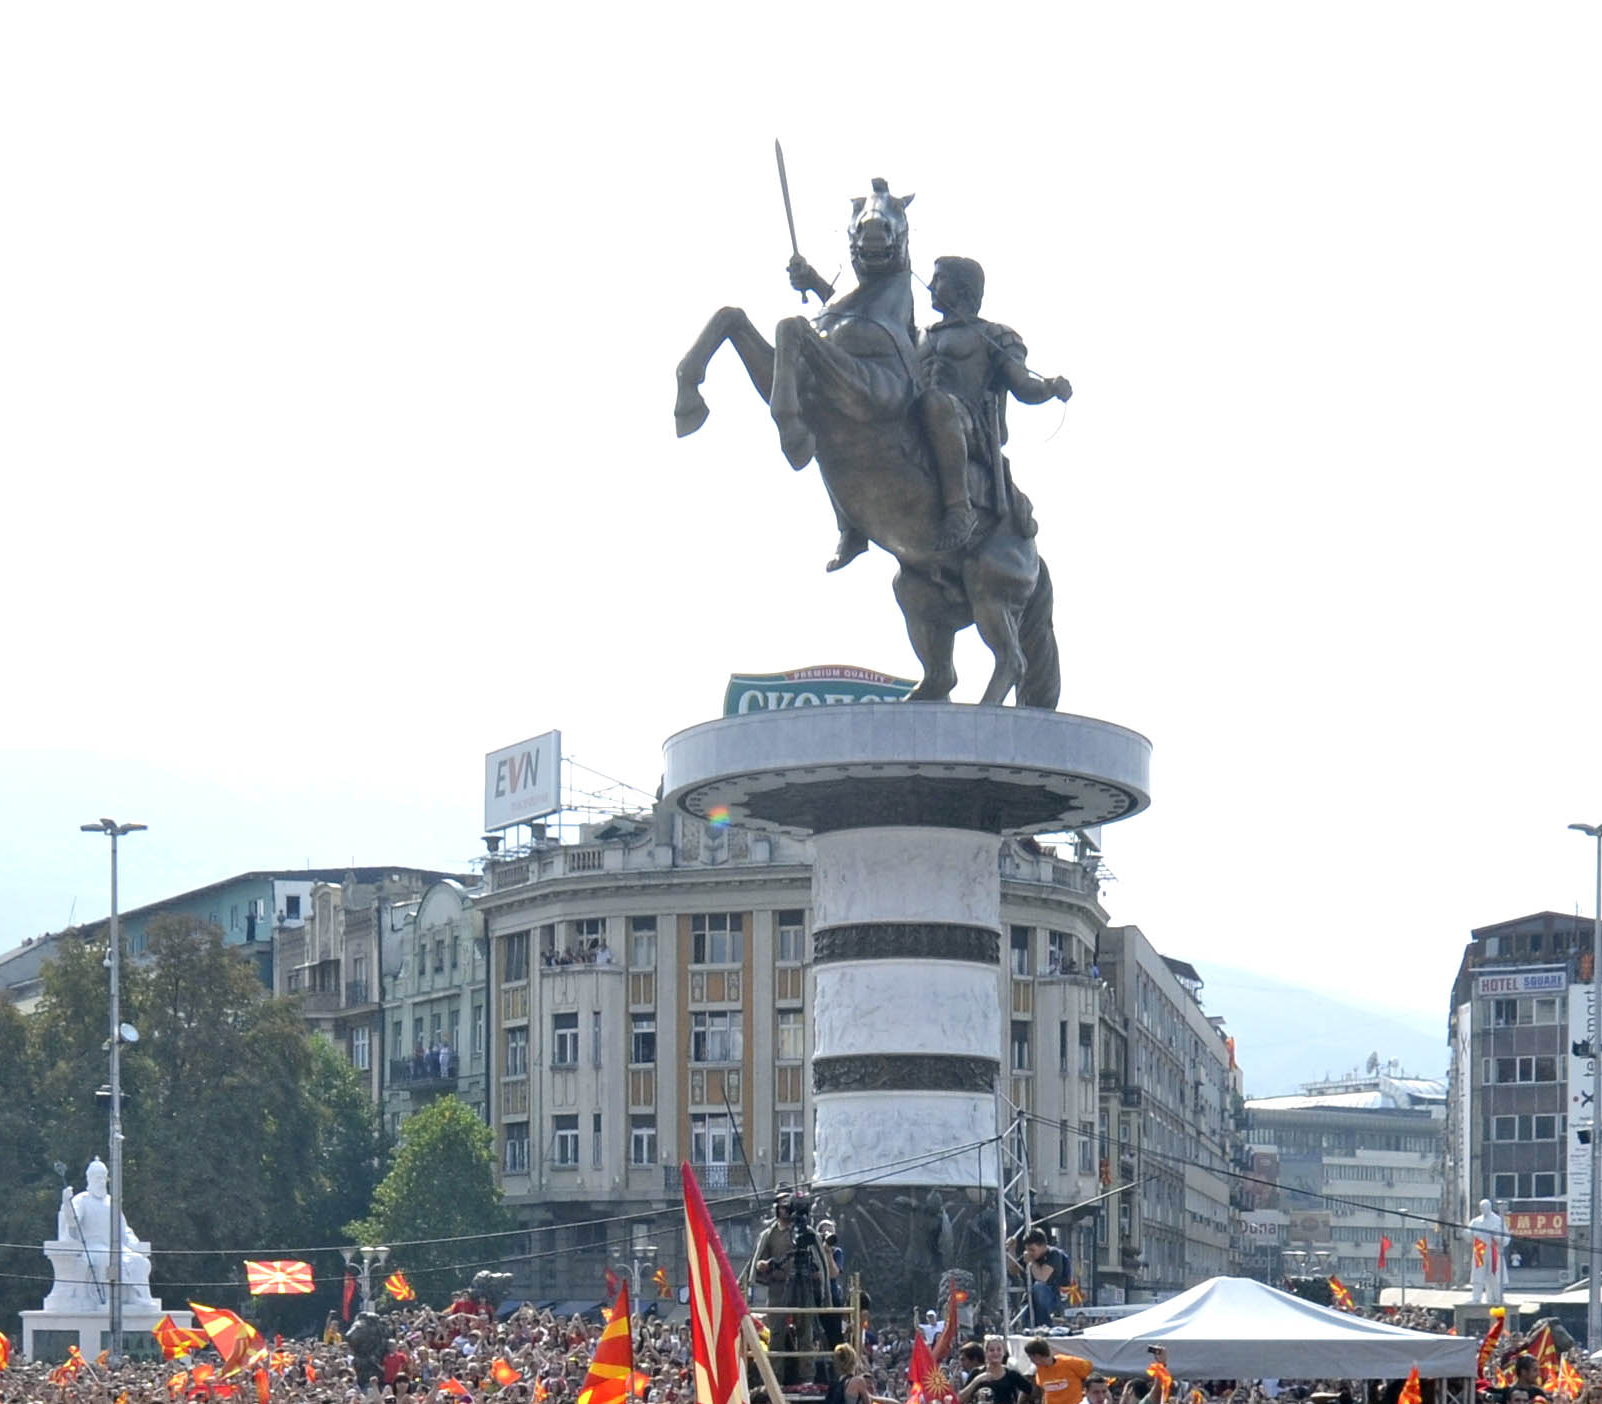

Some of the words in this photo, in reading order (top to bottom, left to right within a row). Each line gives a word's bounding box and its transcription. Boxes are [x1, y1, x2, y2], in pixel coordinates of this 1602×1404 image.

[794, 669, 841, 680] PREMIUM
[844, 669, 885, 682] QUALITY
[495, 747, 540, 799] EVN
[1482, 978, 1519, 992] HOTEL
